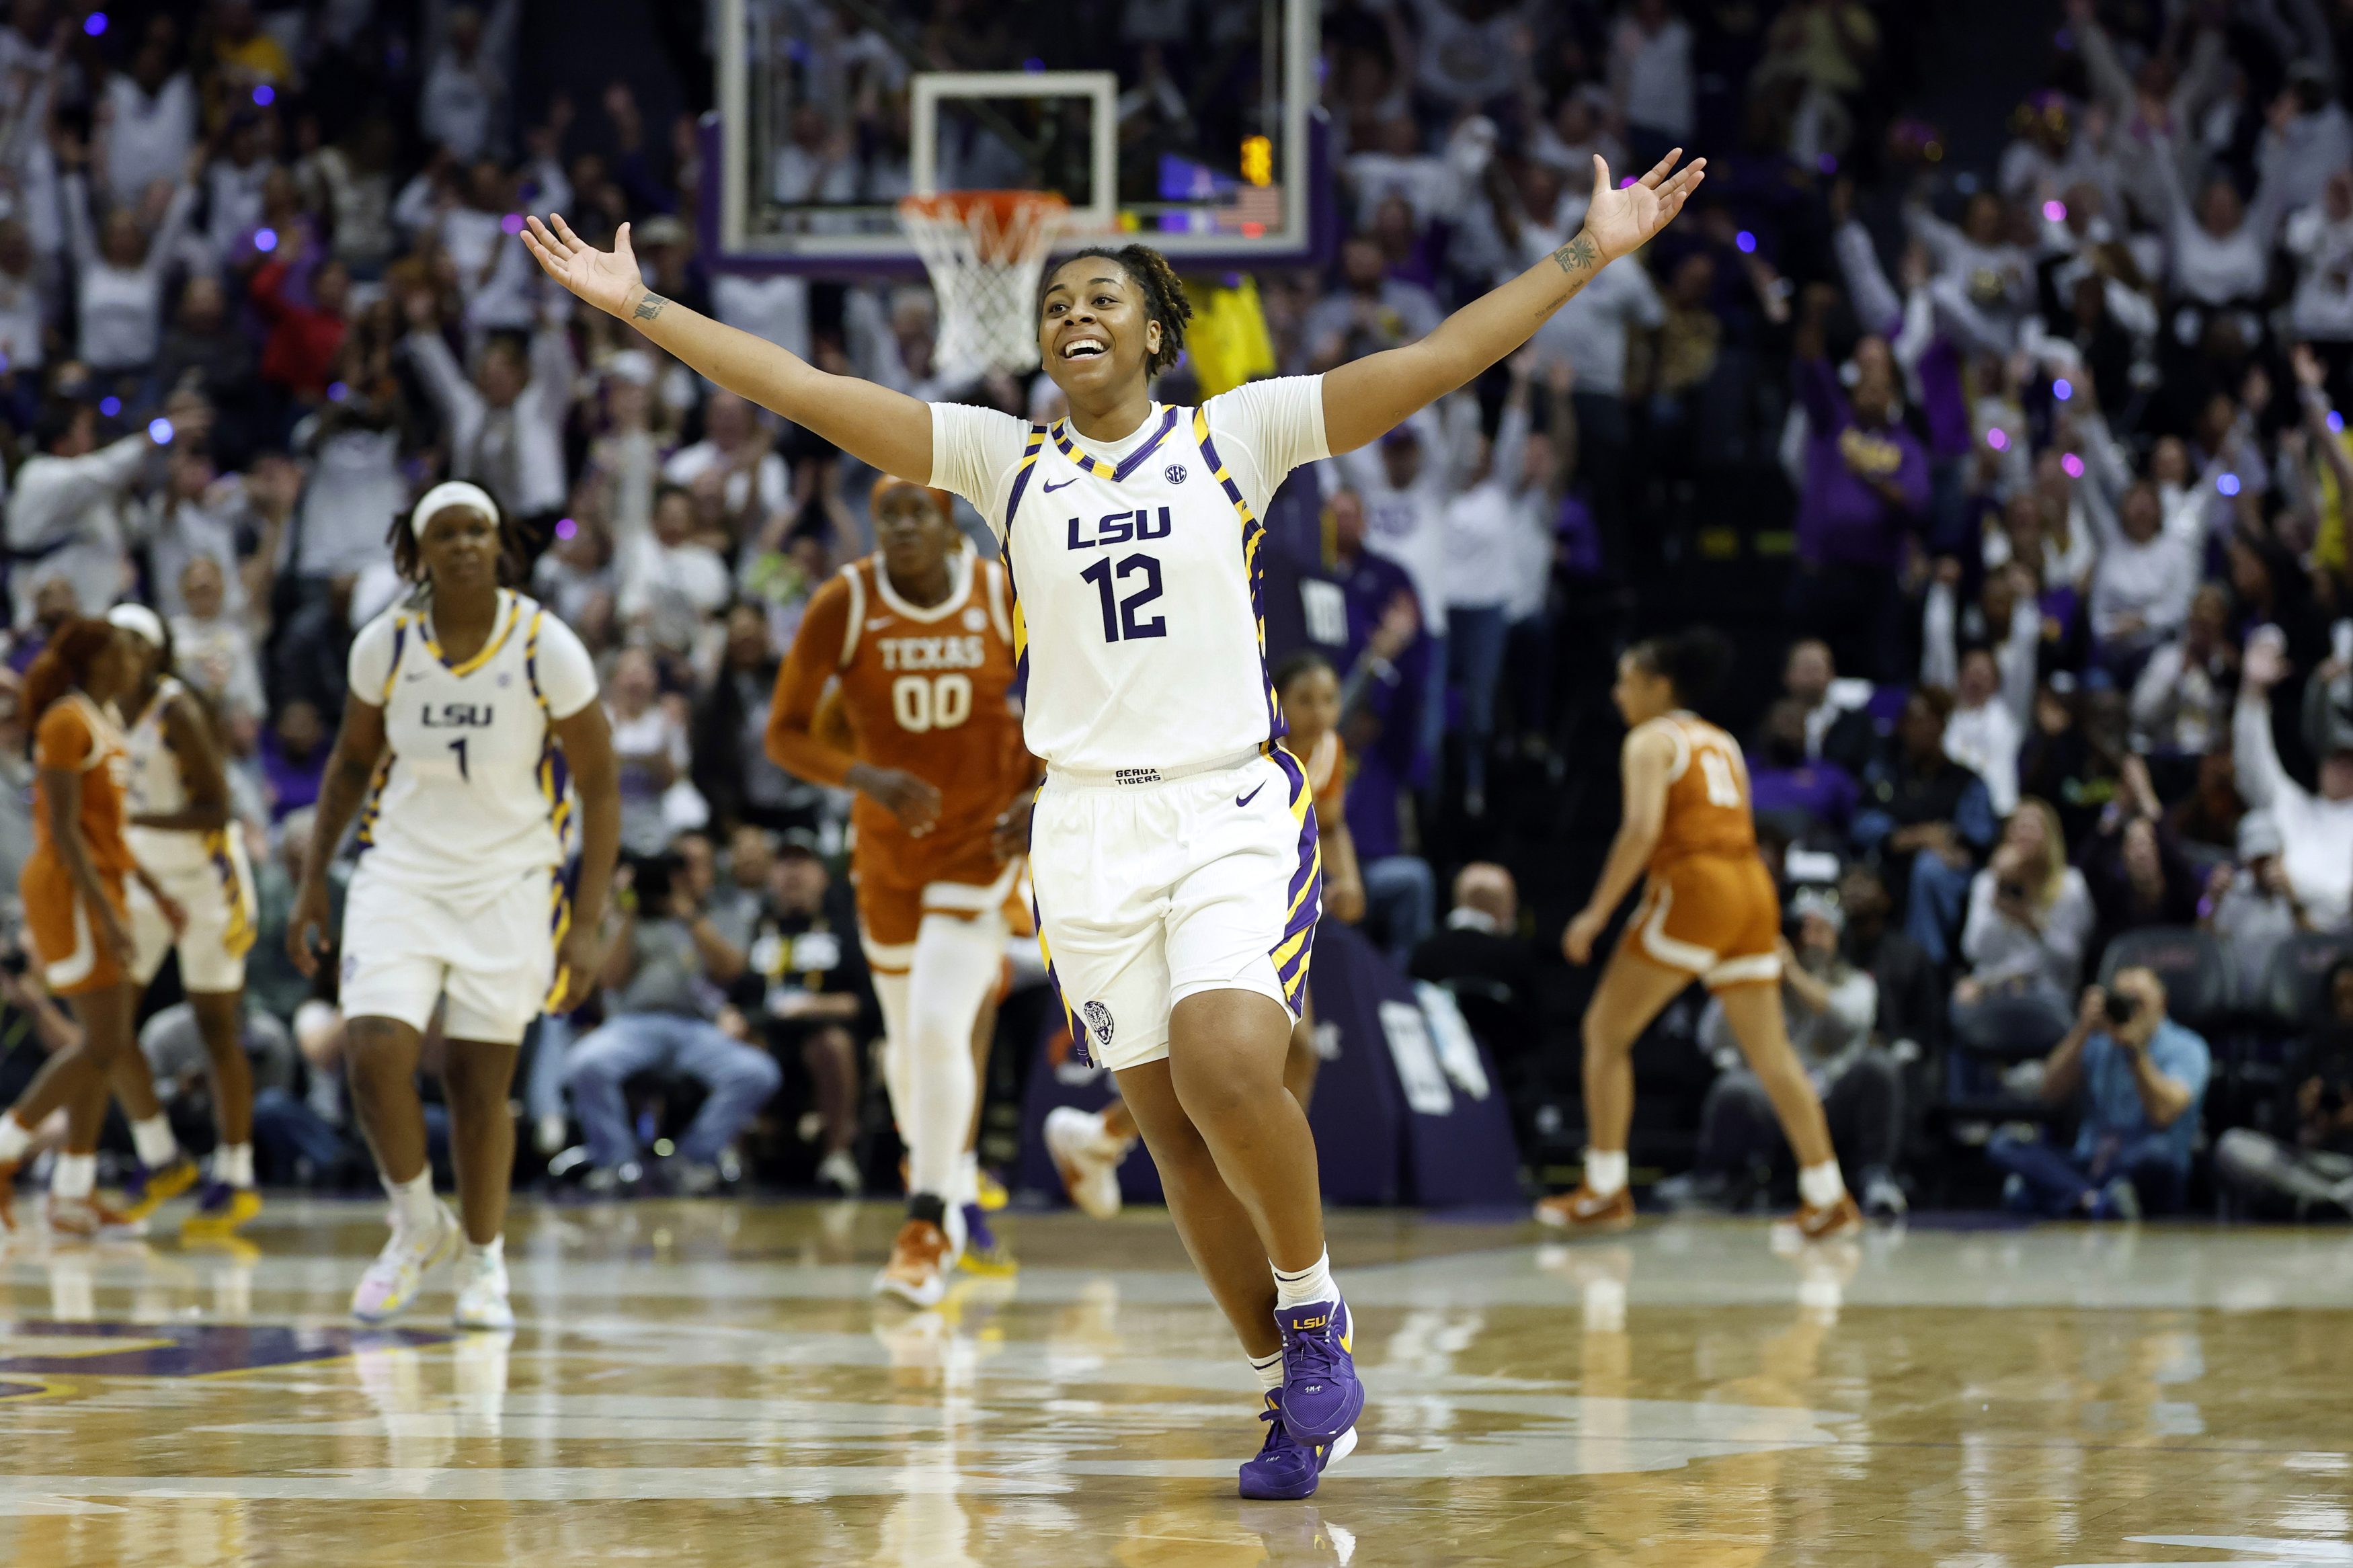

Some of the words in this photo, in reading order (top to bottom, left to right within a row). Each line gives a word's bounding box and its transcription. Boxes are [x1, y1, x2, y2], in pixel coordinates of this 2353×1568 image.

[1167, 466, 1185, 483] SEC
[1068, 506, 1172, 550] LSU
[1080, 553, 1167, 643] 12
[877, 635, 986, 671] TEXAS
[422, 703, 492, 728] LSU
[891, 673, 973, 733] 00
[448, 736, 469, 782] 1
[1116, 768, 1157, 778] GEAUX
[1115, 774, 1161, 785] TIGERS
[1293, 1315, 1326, 1329] LSU
